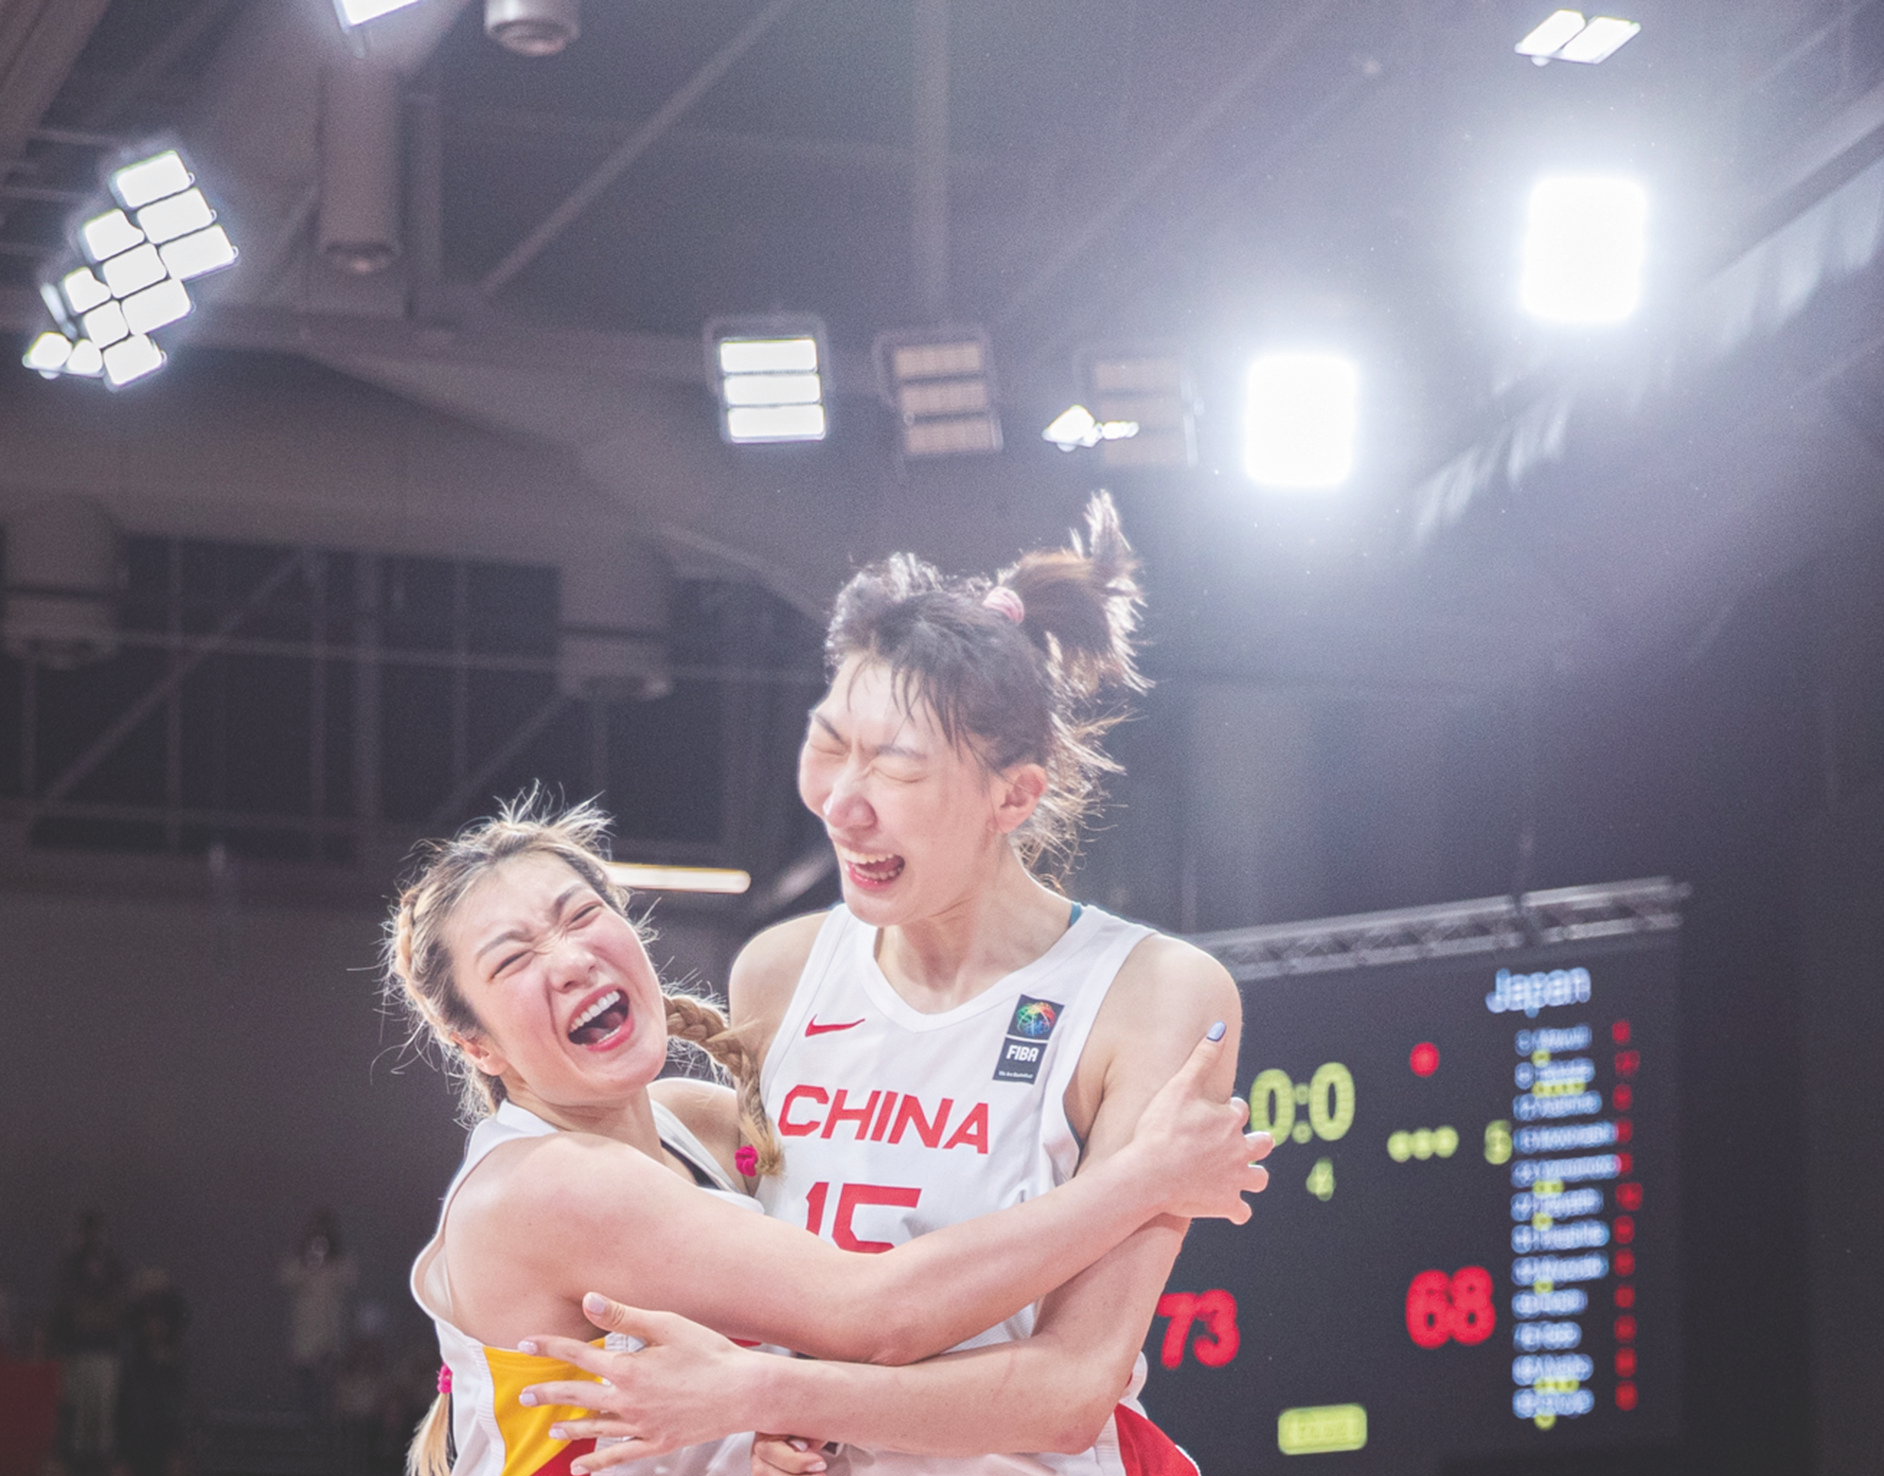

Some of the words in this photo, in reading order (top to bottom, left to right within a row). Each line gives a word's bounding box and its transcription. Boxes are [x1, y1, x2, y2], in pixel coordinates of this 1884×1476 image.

[1006, 1044, 1039, 1062] FIBA
[778, 1084, 988, 1155] CHINA
[1306, 1157, 1336, 1201] 4
[805, 1181, 922, 1254] 15
[1155, 1288, 1240, 1369] 73
[1405, 1265, 1496, 1349] 68
